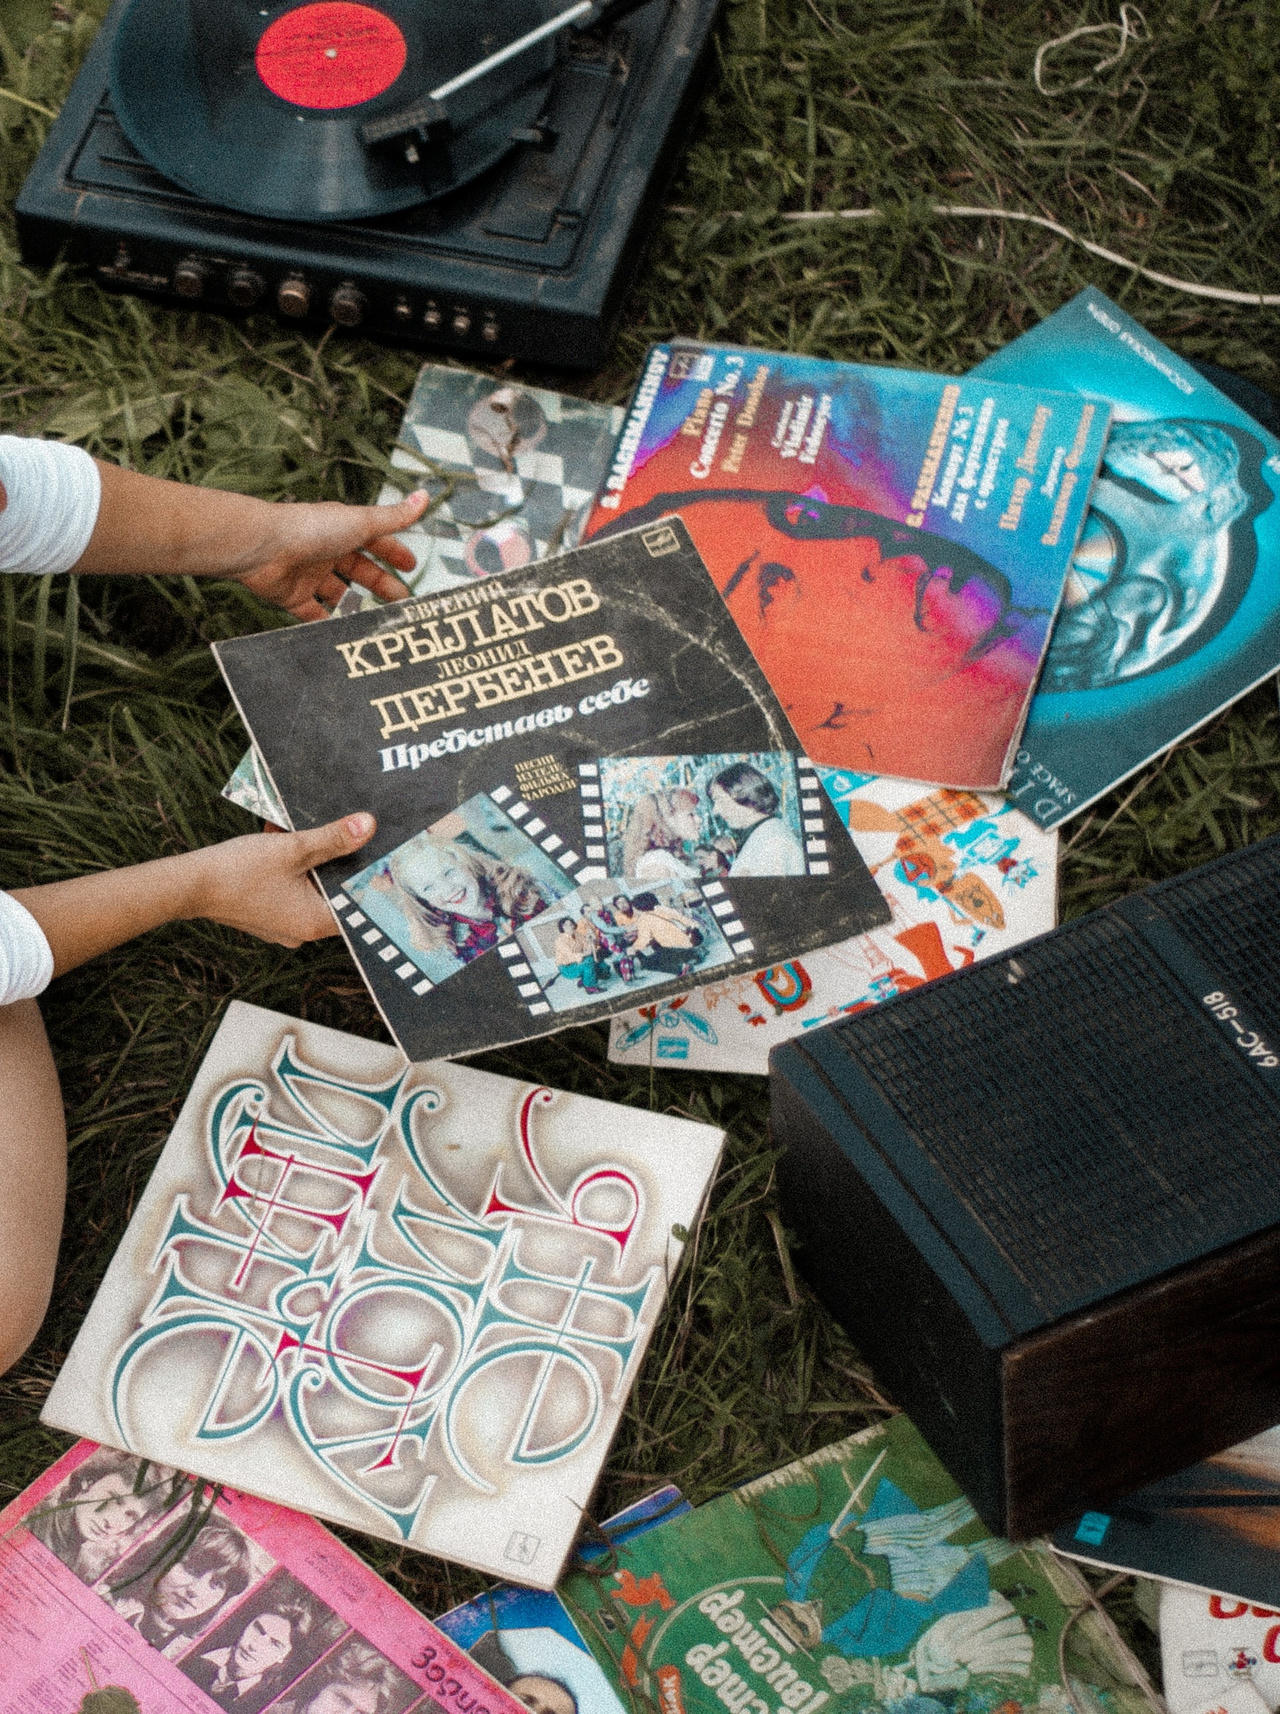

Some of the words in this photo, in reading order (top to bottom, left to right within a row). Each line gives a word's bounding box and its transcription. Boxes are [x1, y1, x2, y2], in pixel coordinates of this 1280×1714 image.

[606, 349, 669, 490] RACHMANINOV
[681, 388, 714, 437] Piano
[689, 401, 730, 479] Concerto
[725, 355, 745, 368] 3
[780, 394, 814, 458] Vladimir
[910, 384, 961, 510] РАХМАНИНОВ
[958, 397, 995, 490] фортепиано
[720, 432, 749, 474] Peter
[931, 444, 964, 508] Концерт
[978, 418, 1010, 498] оркестром
[950, 492, 970, 524] для
[998, 477, 1032, 530] Питер
[1041, 472, 1078, 546] Владимир
[335, 577, 602, 680] КРЫЛАТОВ
[437, 640, 532, 682] ЛЕОНИД
[370, 634, 624, 740] ДЕРБЕНЕВ
[378, 702, 573, 773] Представь
[577, 676, 651, 717] себе
[514, 754, 555, 774] ПЕСНИ
[518, 771, 568, 793] ФИЛЬМА
[484, 1086, 640, 1256] Я
